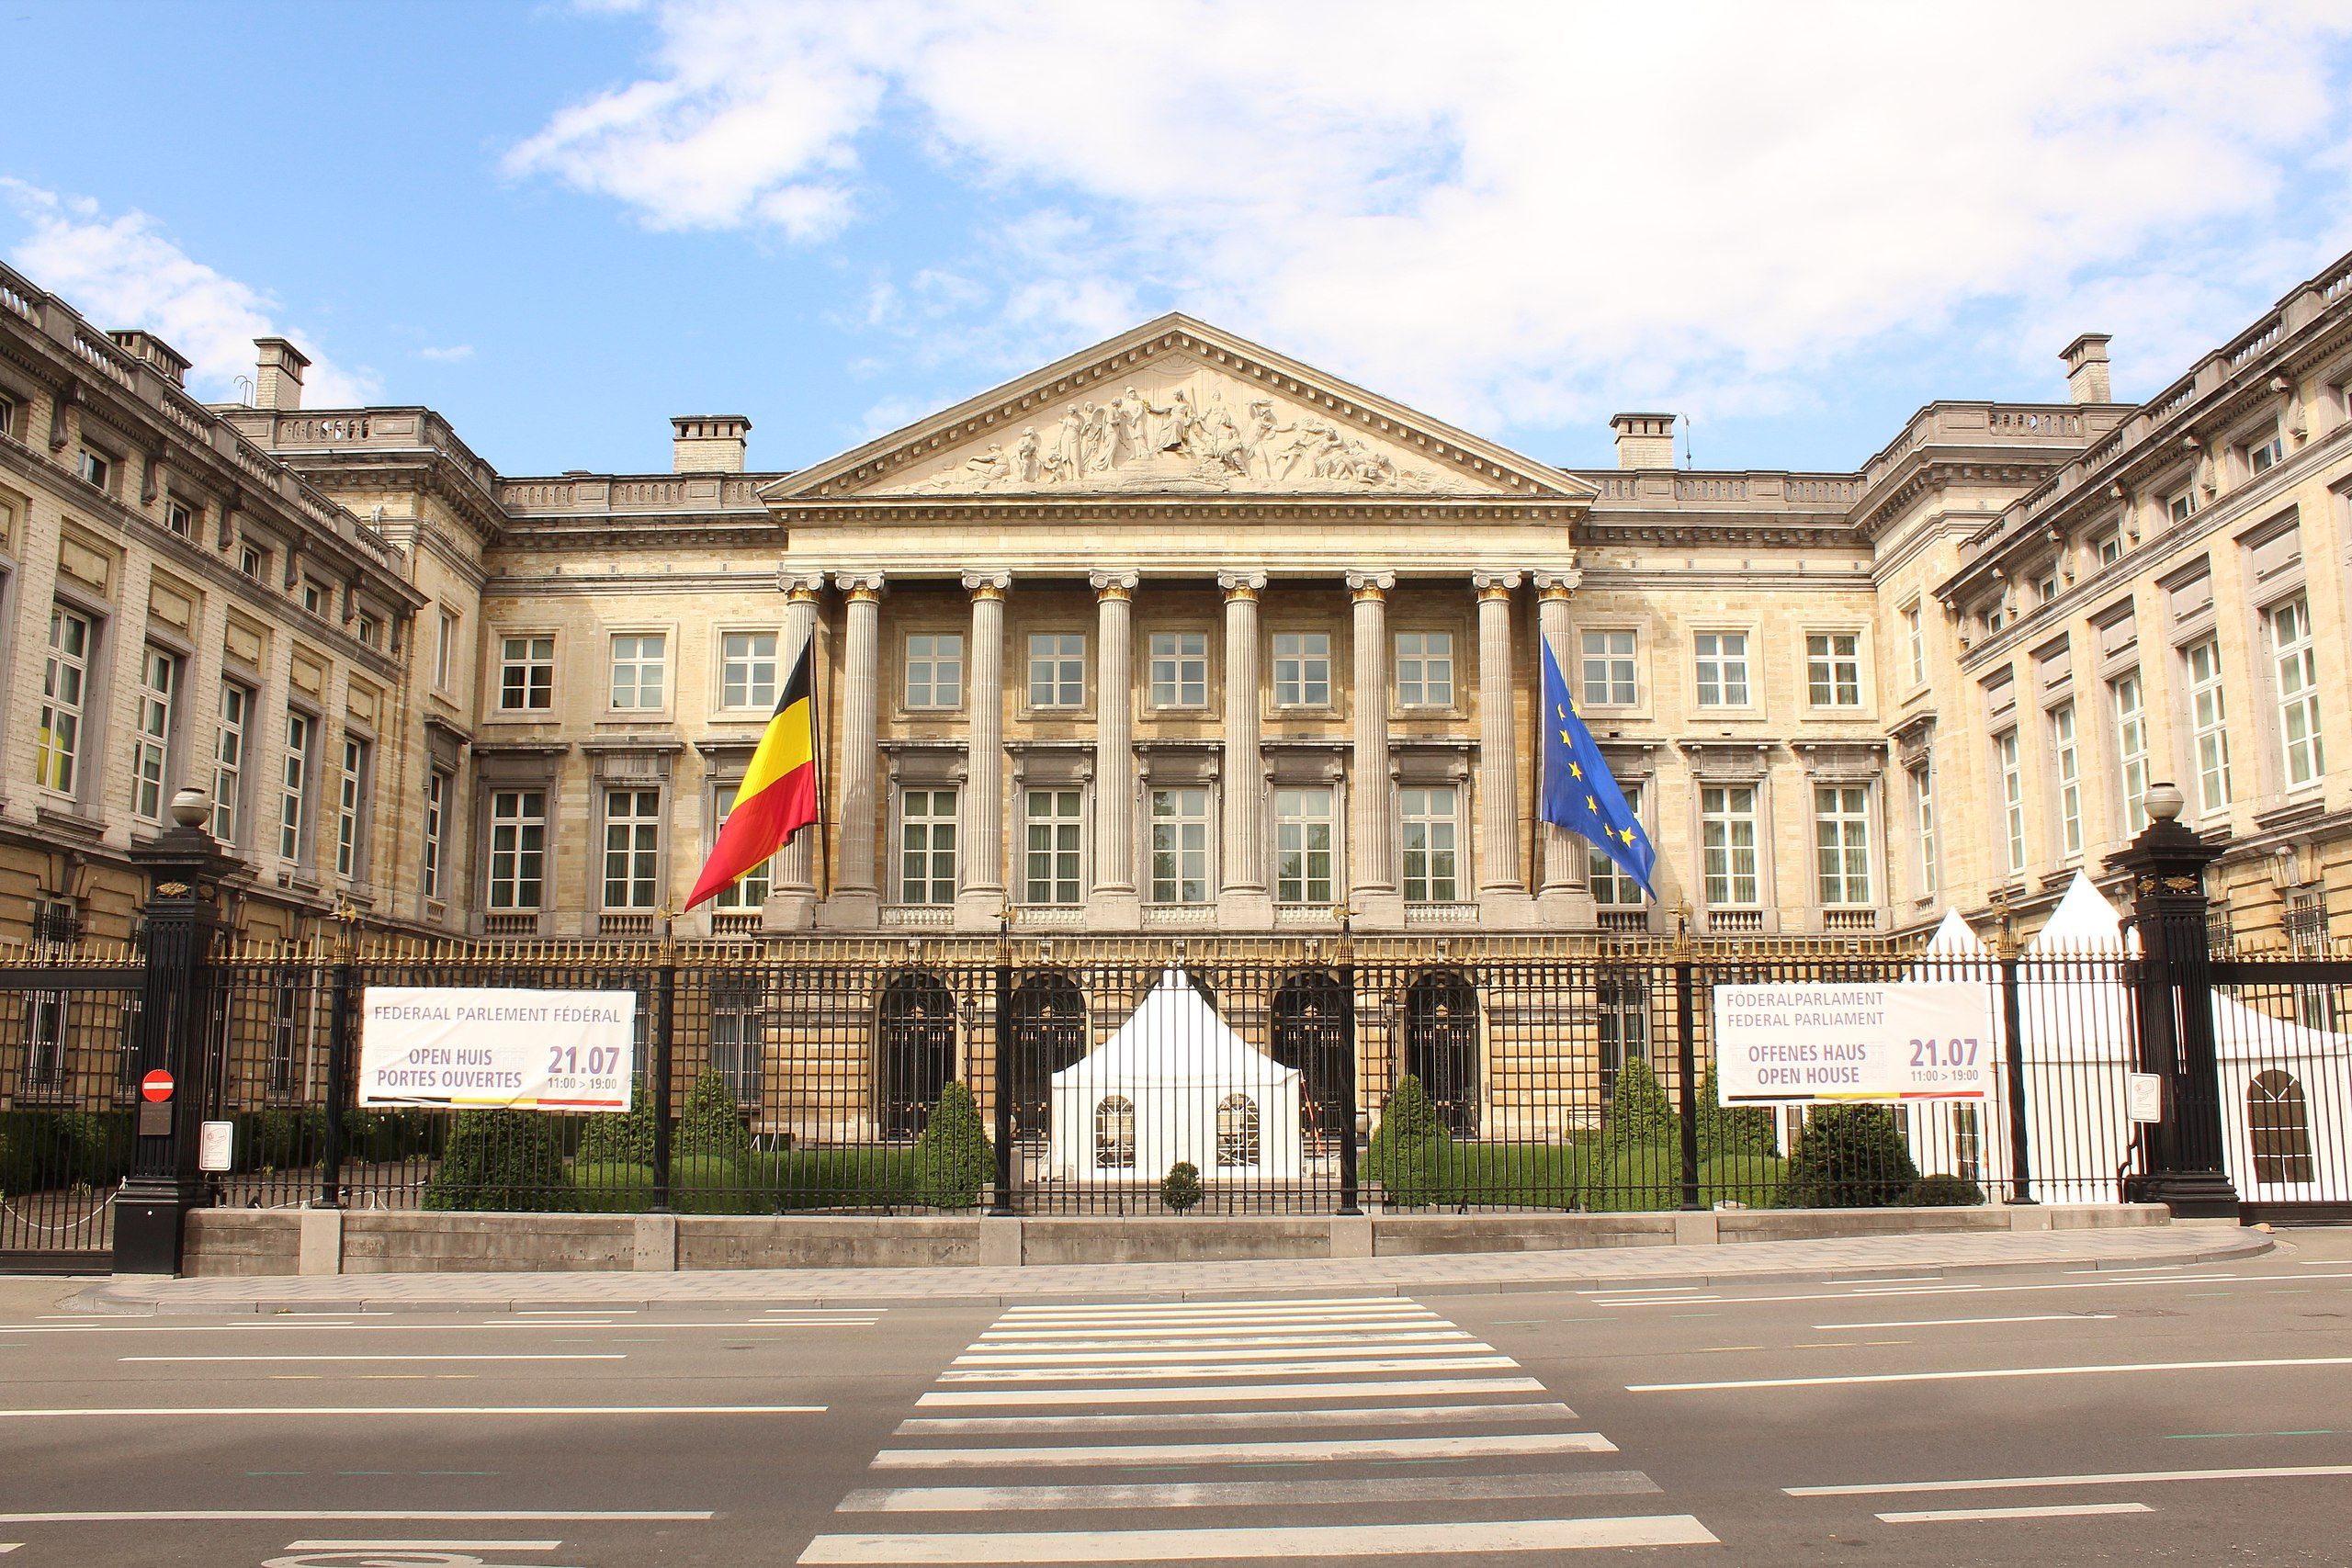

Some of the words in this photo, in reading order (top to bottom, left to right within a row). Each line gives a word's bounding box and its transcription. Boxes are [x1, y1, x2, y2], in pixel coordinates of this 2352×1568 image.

[1727, 990, 1883, 1008] FÖDERALPARLAMENT
[374, 1006, 451, 1021] FEDERAAL
[457, 1007, 548, 1021] PARLEMENT
[553, 1005, 621, 1023] FÉDÉRAL
[1727, 1013, 1791, 1027] FEDERAL
[1794, 1011, 1884, 1026] PARLIAMENT
[409, 1048, 451, 1065] OPEN
[456, 1048, 492, 1066] HUIS
[548, 1045, 620, 1075] 21.07
[1748, 1044, 1818, 1062] OFFENES
[1824, 1043, 1866, 1061] HAUS
[1909, 1038, 1978, 1066] 21.07
[377, 1069, 436, 1088] PORTES
[443, 1070, 522, 1089] OUVERTES
[548, 1077, 576, 1089] 11:00
[589, 1077, 617, 1090] 19:00
[1758, 1067, 1801, 1085] OPEN
[1806, 1066, 1860, 1084] HOUSE
[1911, 1070, 1939, 1082] 11:00
[1951, 1069, 1979, 1081] 19:00
